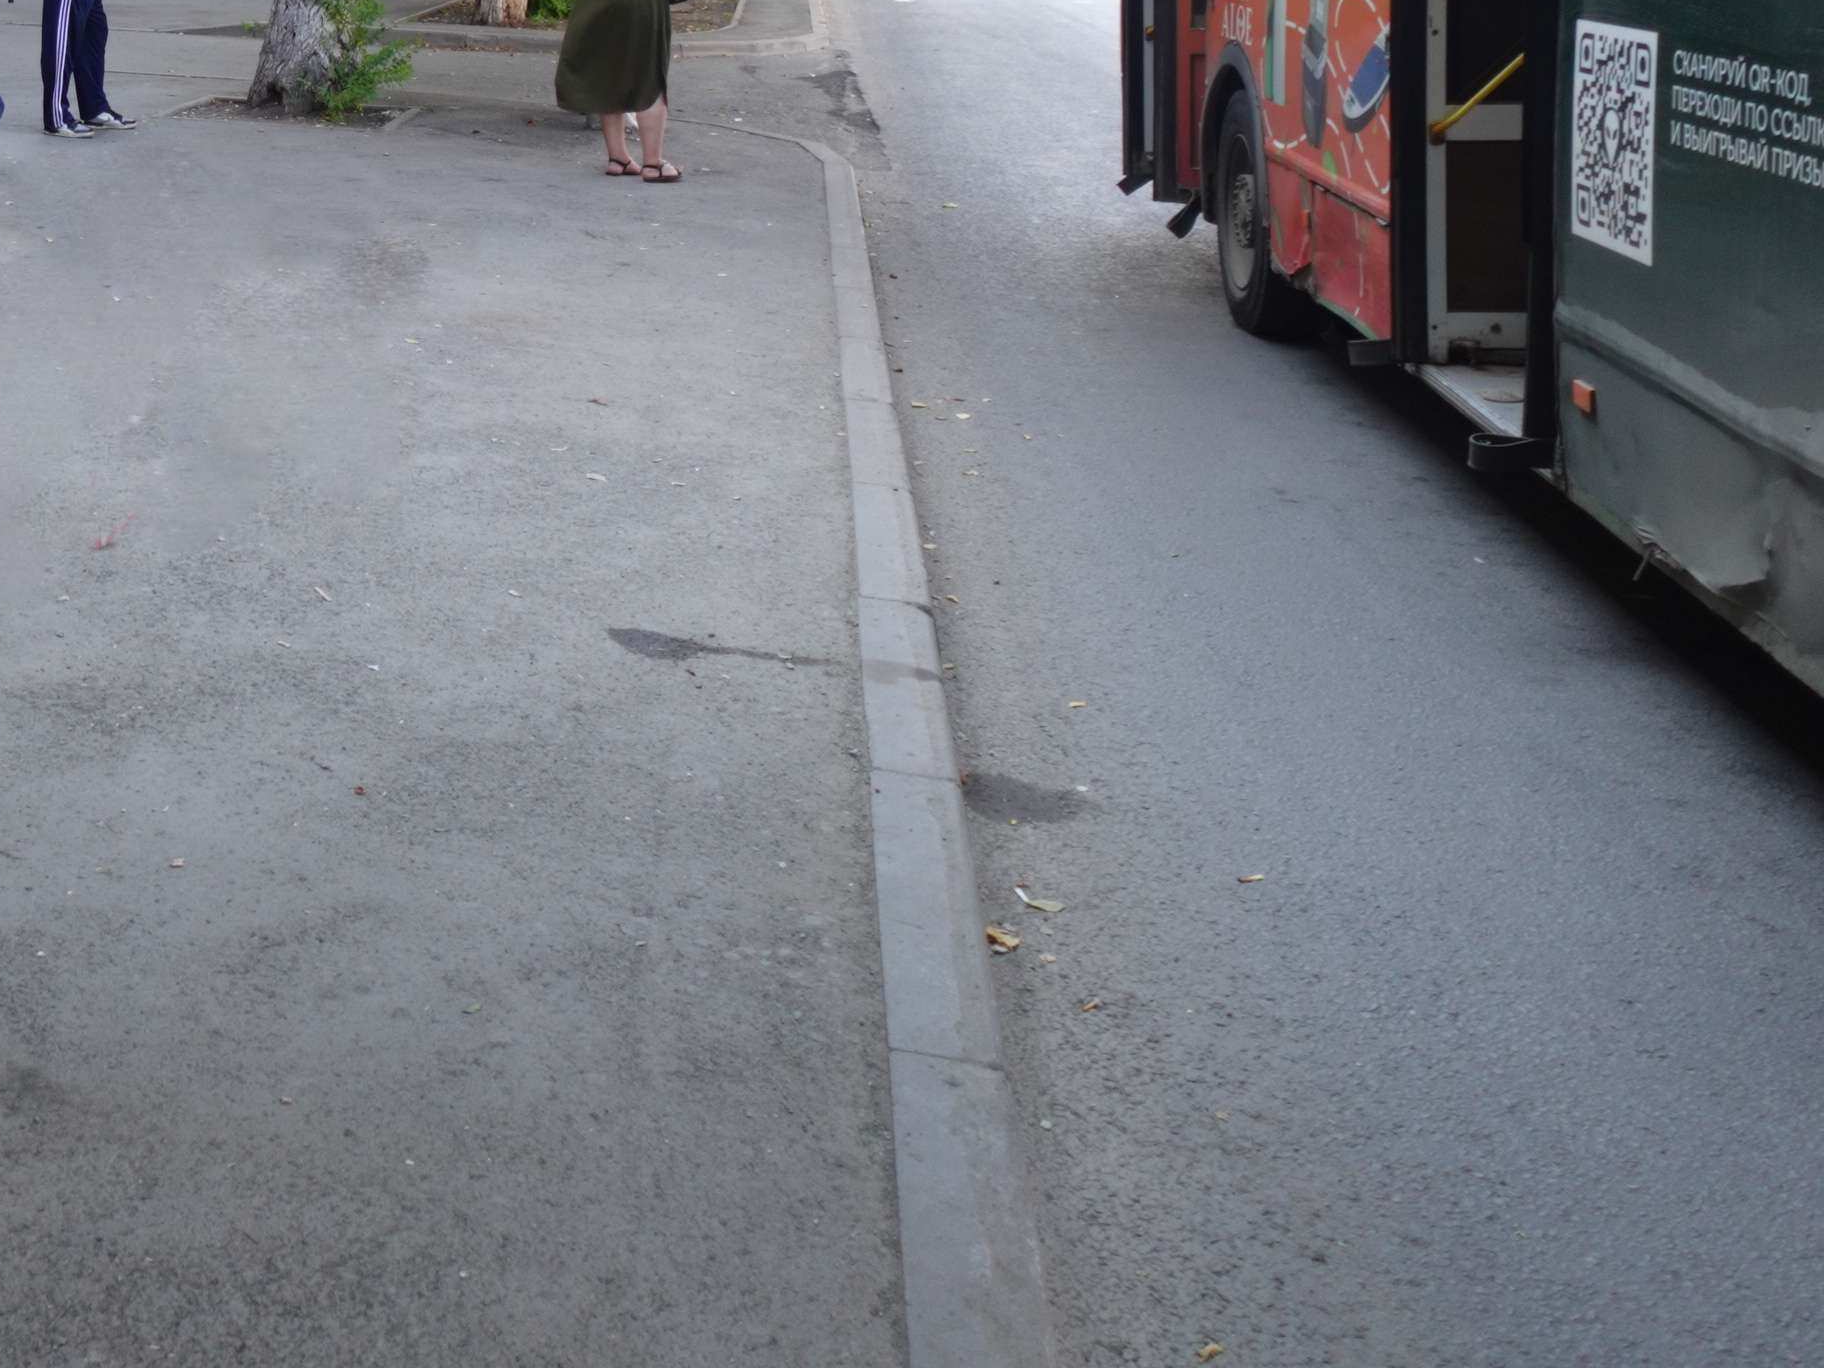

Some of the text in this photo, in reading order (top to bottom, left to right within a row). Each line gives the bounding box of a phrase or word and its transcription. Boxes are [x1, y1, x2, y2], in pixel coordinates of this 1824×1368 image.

[1673, 49, 1747, 89] СКАНИРУЙ
[1671, 84, 1743, 128] ПЕРЕХОДИ
[1744, 101, 1768, 132] ПО
[1670, 119, 1682, 146] И
[1683, 122, 1769, 172] ВЫИГРЫВАЙ
